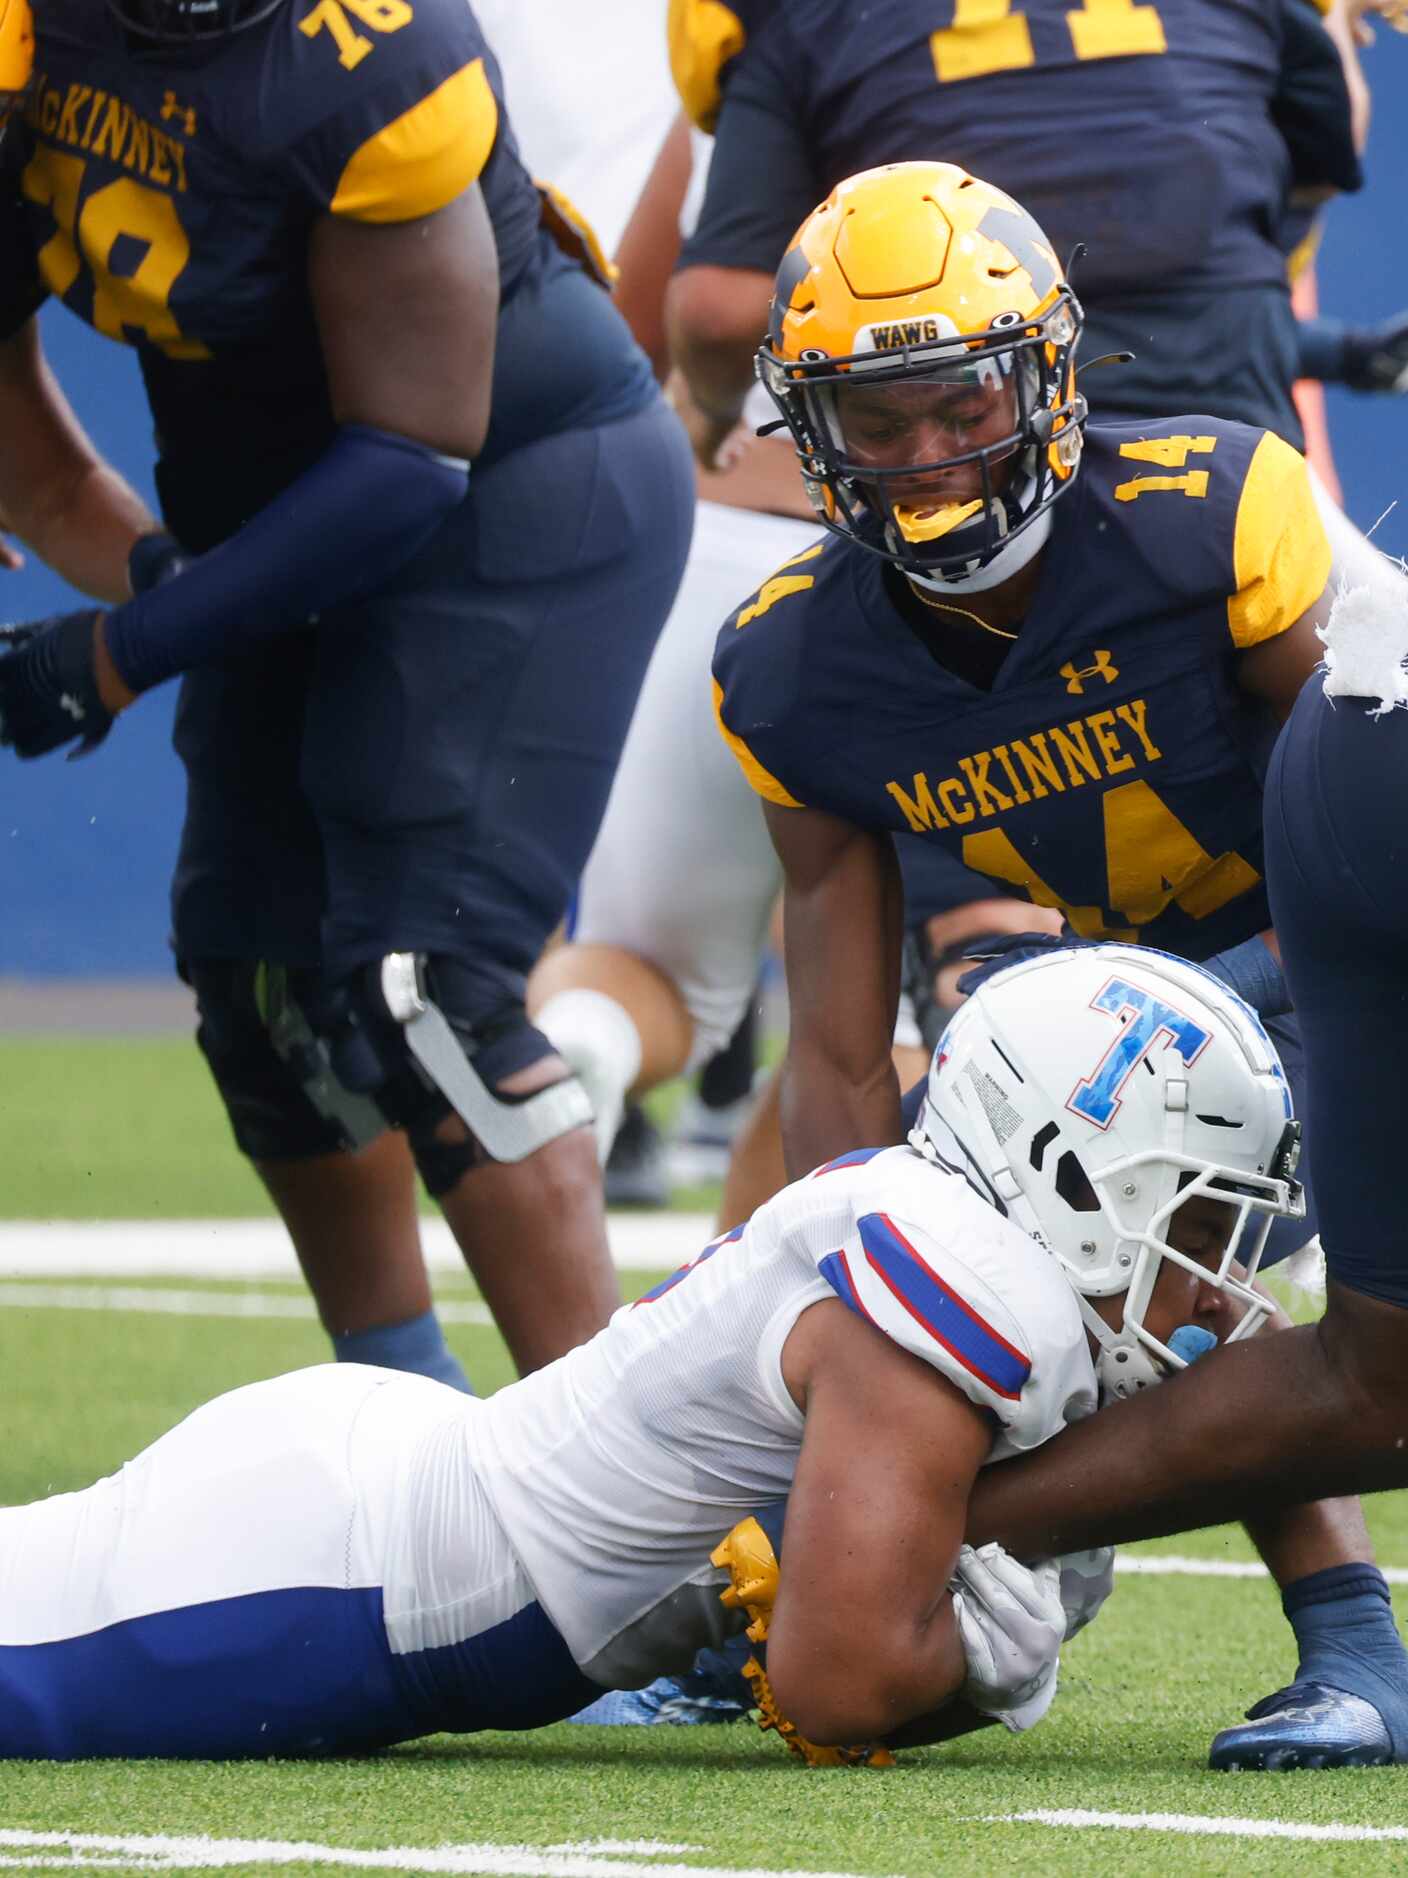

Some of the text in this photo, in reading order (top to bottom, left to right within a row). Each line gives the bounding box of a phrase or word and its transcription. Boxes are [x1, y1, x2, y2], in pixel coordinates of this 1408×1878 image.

[33, 73, 188, 193] cKINNEY
[22, 142, 213, 361] 78
[869, 319, 938, 352] WAWG
[1114, 436, 1217, 502] 14
[962, 779, 1262, 944] 14
[1064, 974, 1214, 1132] T
